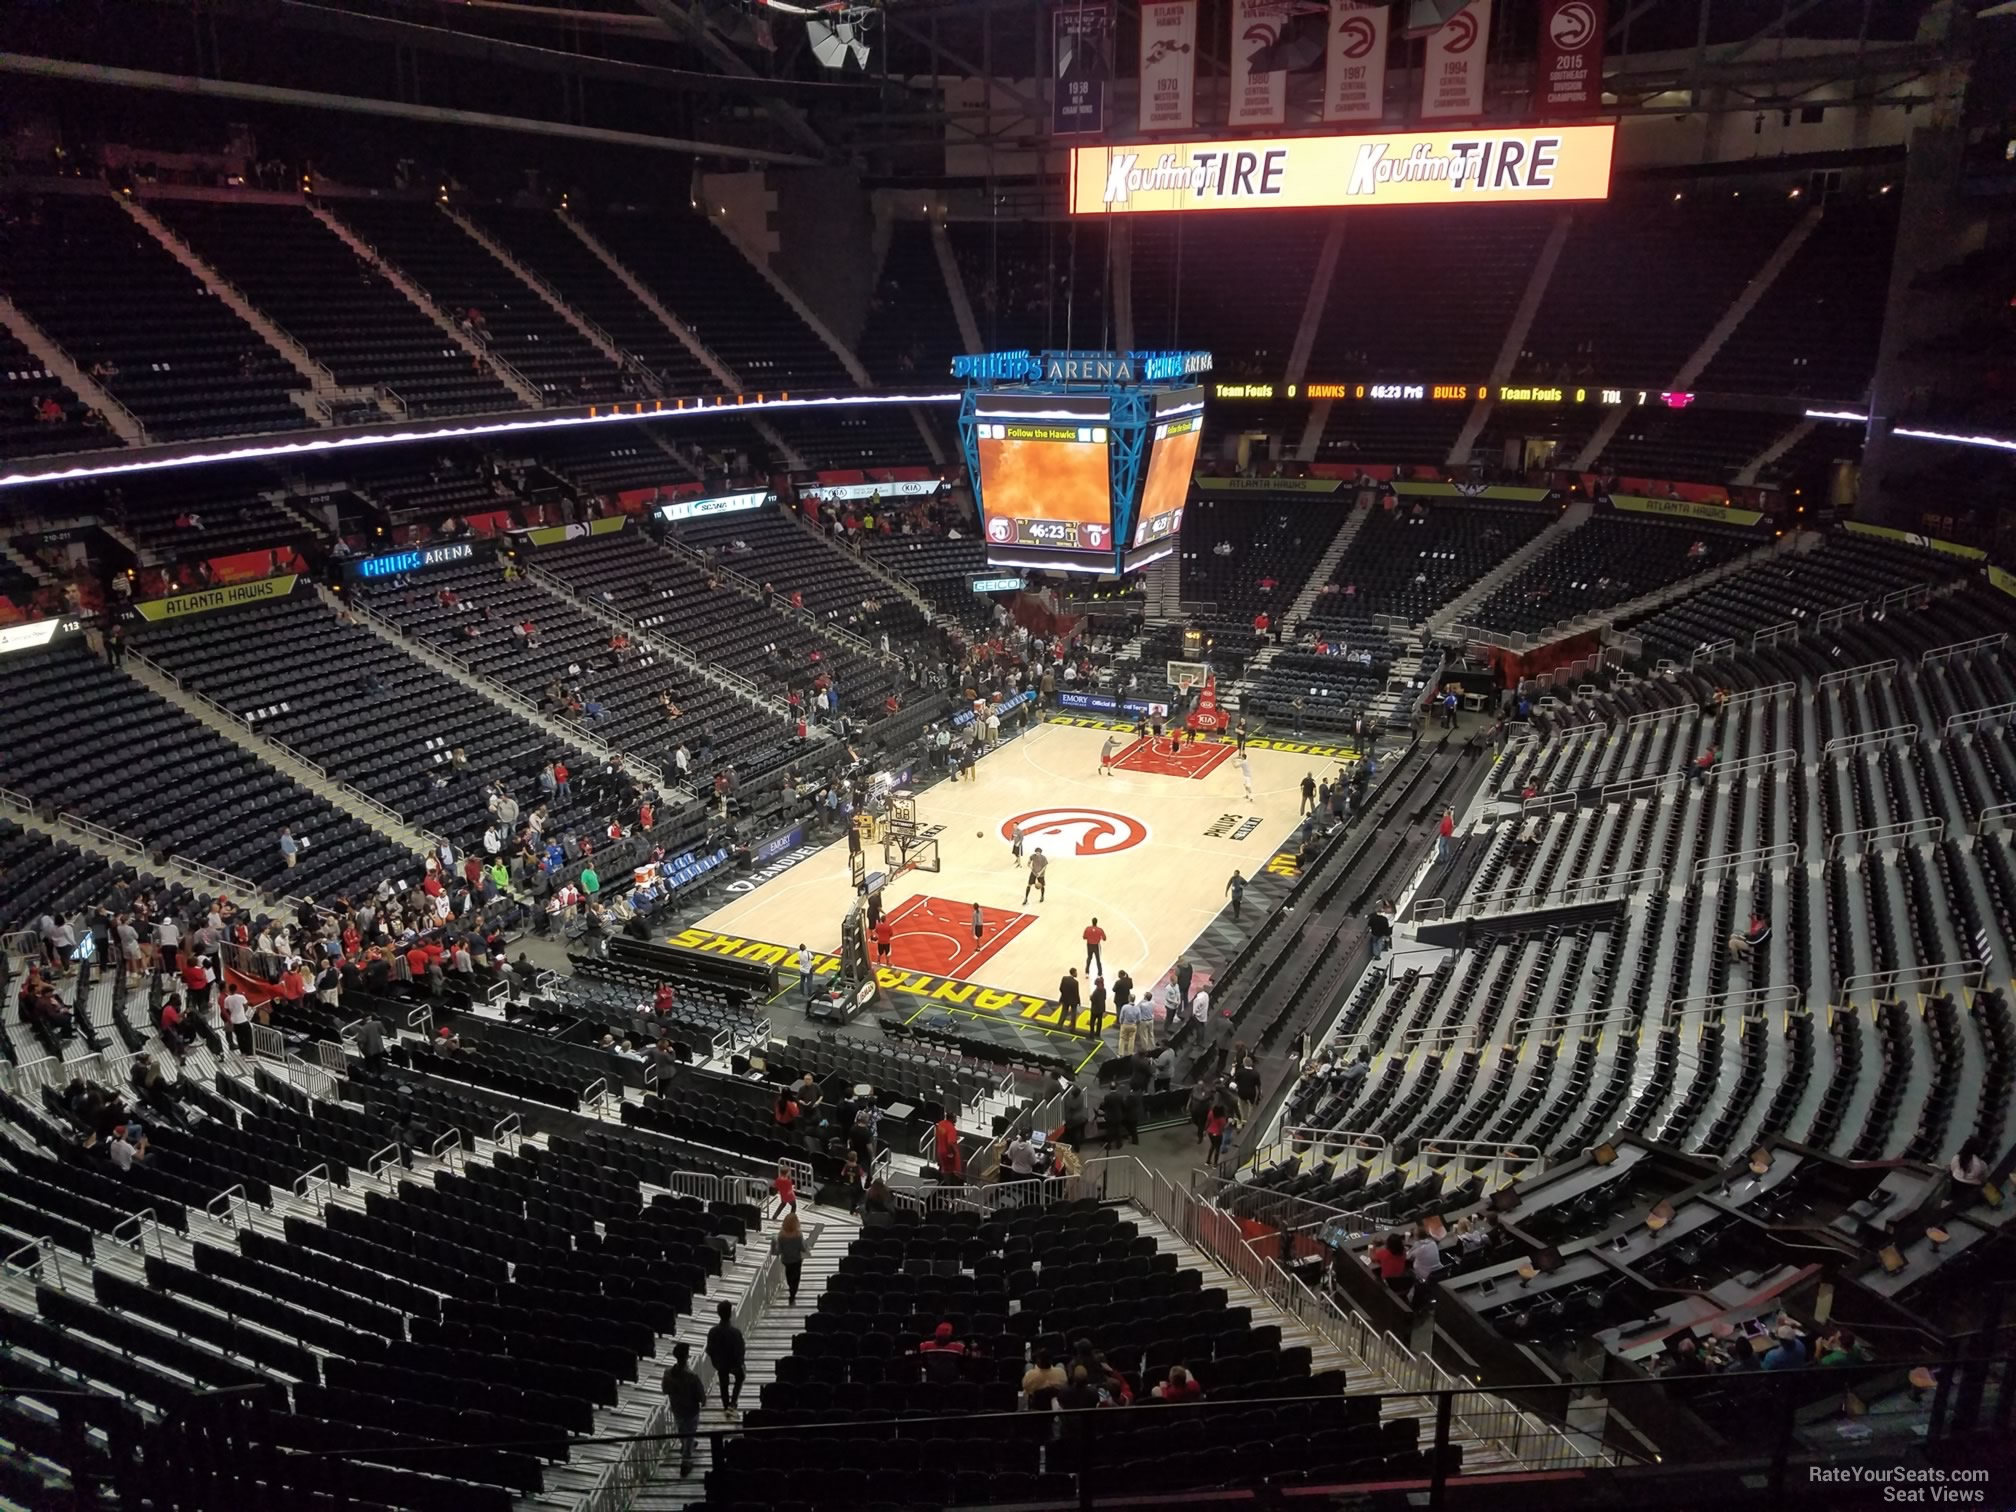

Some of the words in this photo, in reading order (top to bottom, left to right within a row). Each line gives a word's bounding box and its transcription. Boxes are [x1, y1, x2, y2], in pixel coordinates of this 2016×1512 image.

[1154, 7, 1184, 17] ATLANTA
[1156, 17, 1181, 27] HAWKS
[1444, 62, 1467, 75] 1994
[1557, 55, 1582, 70] 2015
[1344, 66, 1366, 80] 1987
[1550, 70, 1587, 80] SOUTHEAST
[1158, 79, 1178, 91] 1970
[1346, 143, 1481, 195] Kauffman
[1451, 139, 1558, 188] TIRE
[1103, 154, 1219, 203] Kauffman
[1193, 150, 1286, 196] TIRE
[951, 356, 1043, 380] PHILIPS
[1050, 361, 1131, 380] ARENA
[1216, 385, 1244, 398] Team
[1246, 385, 1273, 398] Fouls
[1288, 385, 1296, 397] 0
[1308, 386, 1345, 398] HAWKS
[1357, 386, 1364, 397] 0
[1371, 386, 1401, 398] 46:23
[1433, 387, 1467, 399] BULLS
[1479, 387, 1487, 399] 0
[1501, 388, 1531, 400] Team
[1532, 388, 1562, 401] Fouls
[1576, 389, 1585, 402] 0
[1602, 390, 1622, 404] TOL
[1638, 391, 1646, 405] 7
[1007, 429, 1034, 437] Follow
[1035, 429, 1048, 438] the
[1049, 430, 1076, 439] Hawks
[1229, 480, 1271, 488] ATLANTA
[1273, 481, 1307, 489] HAWKS
[1646, 501, 1690, 513] ATLANTA
[1693, 505, 1727, 520] HAWKS
[1029, 524, 1065, 539] 46:23
[1090, 532, 1101, 546] 0
[363, 551, 421, 576] PHILIPS
[425, 545, 473, 564] ARENA
[975, 580, 1019, 591] GEICO
[166, 590, 225, 614] ATLANTA
[228, 582, 273, 602] HAWKS
[121, 611, 135, 620] 114
[62, 621, 80, 632] 113
[1062, 694, 1088, 703] EMORY
[770, 833, 791, 852] EMORY
[750, 845, 824, 882] FANDUEL
